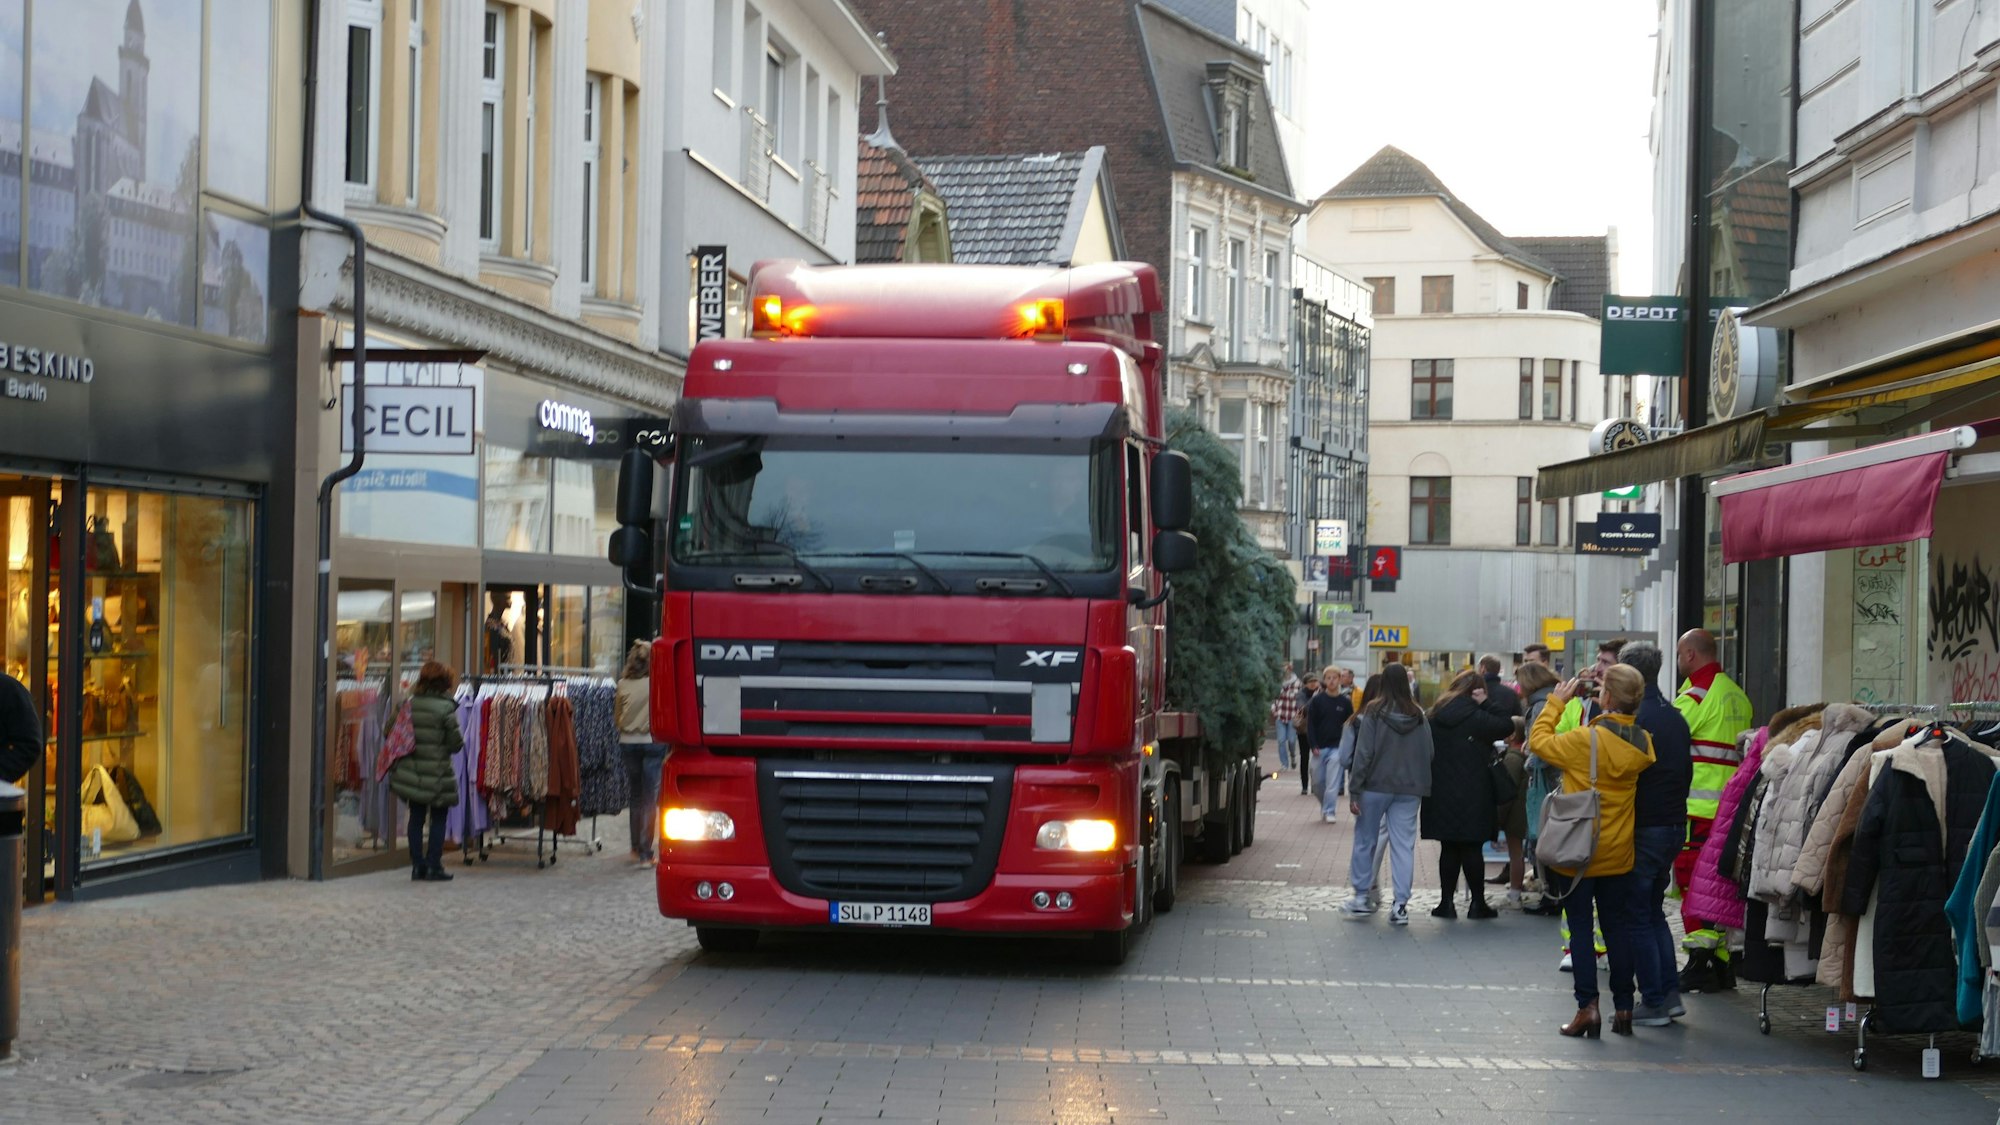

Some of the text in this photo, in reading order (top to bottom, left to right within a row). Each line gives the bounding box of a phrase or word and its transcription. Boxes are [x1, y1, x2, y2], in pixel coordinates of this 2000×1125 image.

[700, 253, 724, 341] WEBER
[1606, 305, 1678, 320] DEPOT
[8, 378, 47, 402] Berlin
[363, 404, 466, 437] CECIL
[700, 644, 775, 661] DAF
[1019, 650, 1079, 667] XF
[840, 905, 928, 922] SU P 1148
